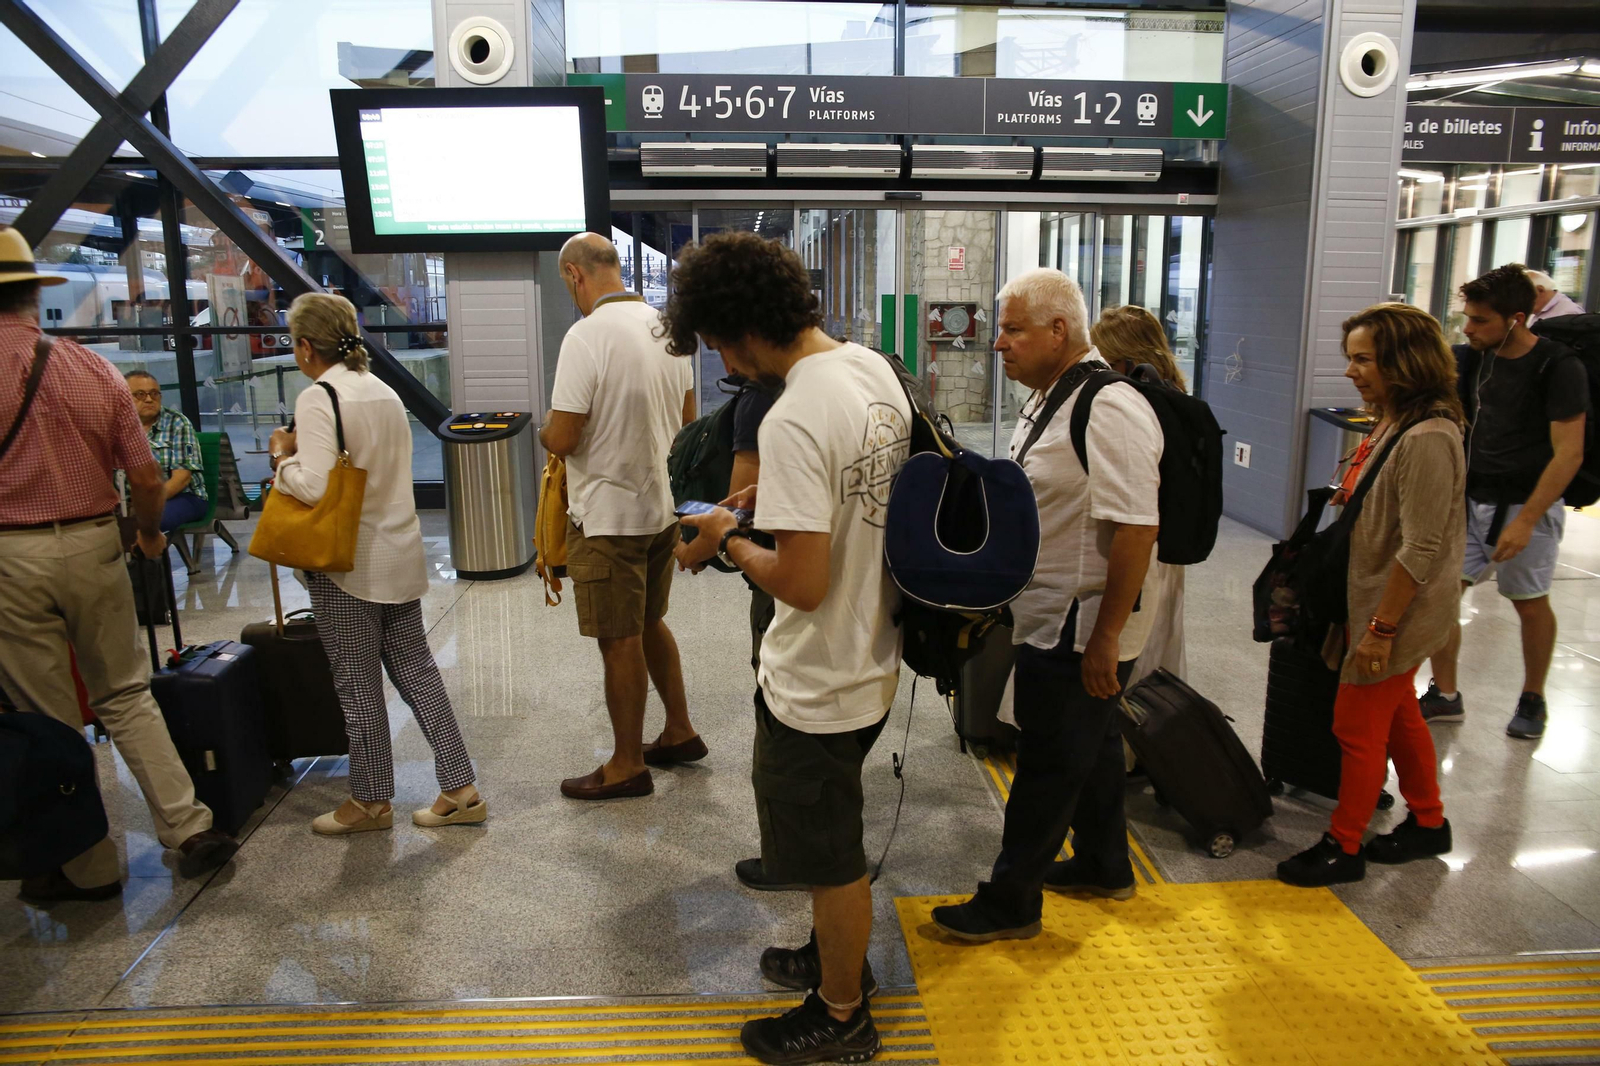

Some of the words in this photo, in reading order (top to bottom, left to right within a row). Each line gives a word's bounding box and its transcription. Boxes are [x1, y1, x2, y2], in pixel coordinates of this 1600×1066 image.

[809, 85, 845, 103] Vías
[1028, 90, 1063, 108] Vías
[809, 109, 876, 121] PLATFORMS
[997, 112, 1062, 125] PLATFORMS
[1419, 118, 1438, 134] de
[1443, 118, 1502, 135] billetes
[1403, 140, 1425, 150] ALES
[315, 229, 325, 246] 2
